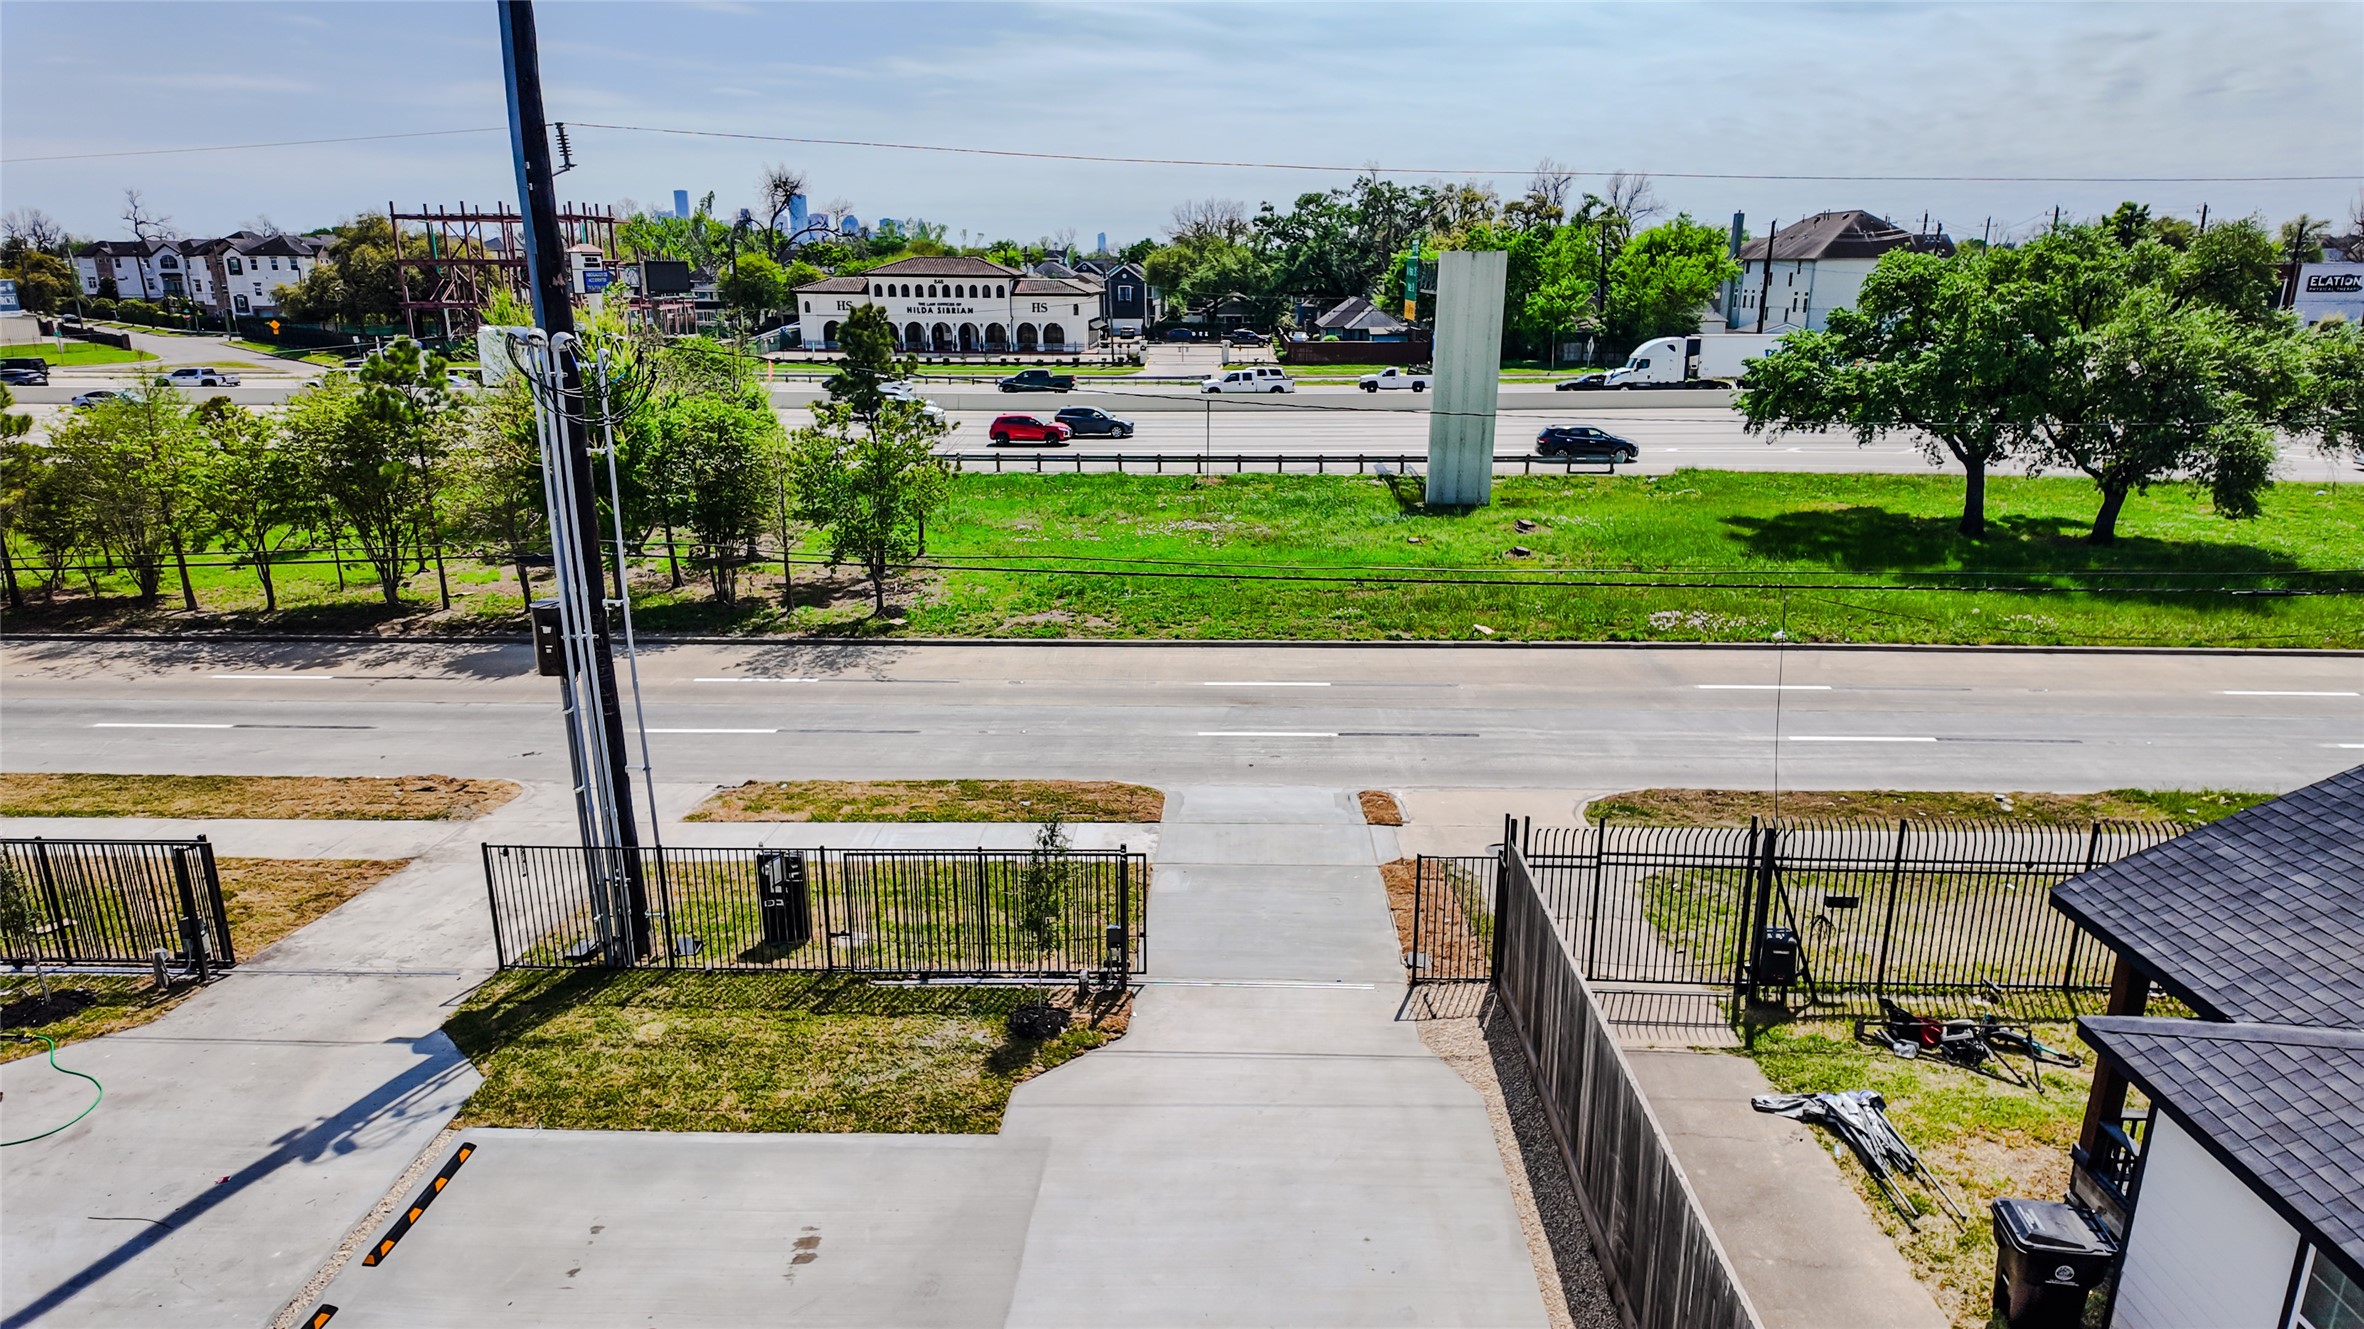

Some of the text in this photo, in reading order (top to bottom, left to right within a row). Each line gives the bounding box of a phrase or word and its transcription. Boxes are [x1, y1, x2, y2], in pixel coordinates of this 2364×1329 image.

[2310, 276, 2362, 286] ELATION
[837, 300, 853, 311] HS
[906, 306, 974, 314] HILDA SIBRIAN
[1032, 302, 1048, 313] HS
